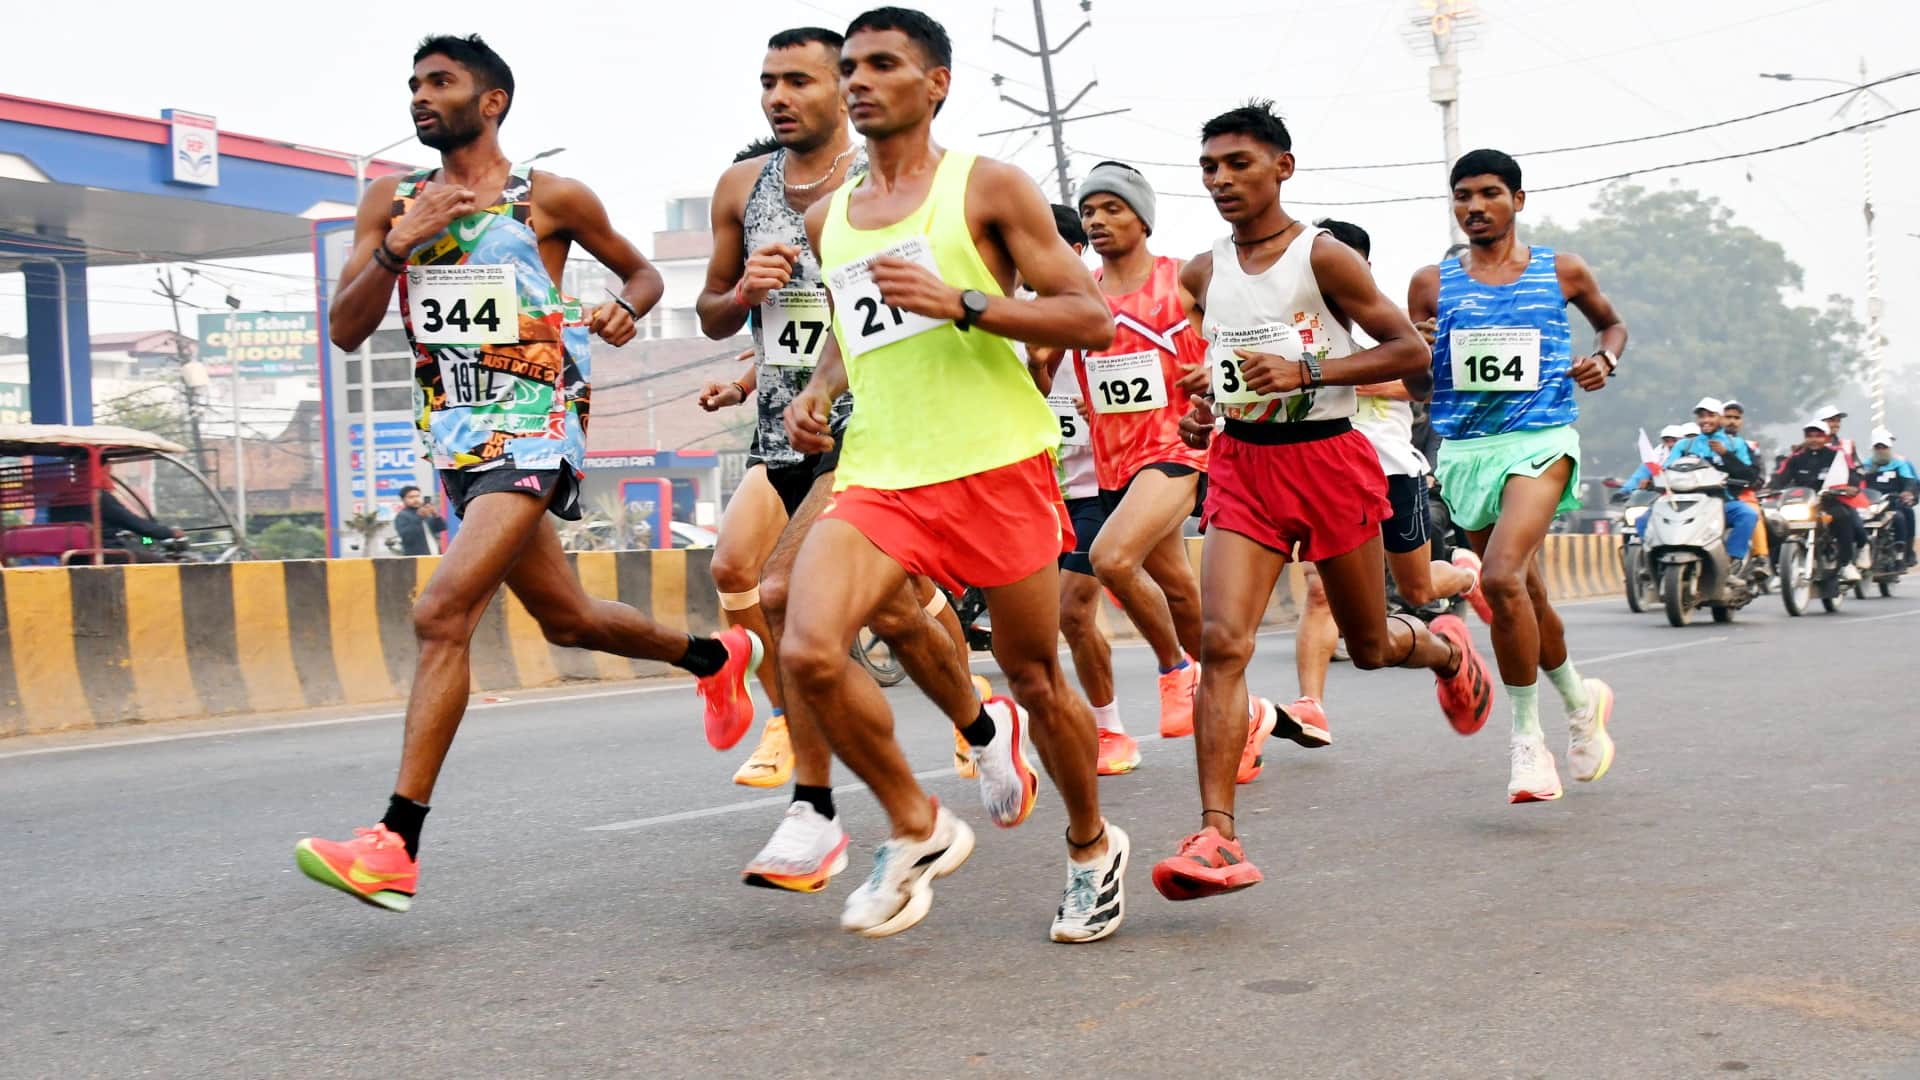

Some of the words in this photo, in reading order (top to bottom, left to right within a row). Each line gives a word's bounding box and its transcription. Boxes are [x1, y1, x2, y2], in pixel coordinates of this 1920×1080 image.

[255, 316, 306, 330] School
[420, 298, 500, 333] 344
[778, 320, 828, 355] 47
[1234, 328, 1269, 337] MARATHON
[482, 354, 509, 370] JUST
[511, 359, 527, 374] DO
[1220, 360, 1254, 393] 3
[1464, 355, 1523, 382] 164
[1099, 377, 1152, 405] 192
[377, 450, 415, 468] PUC
